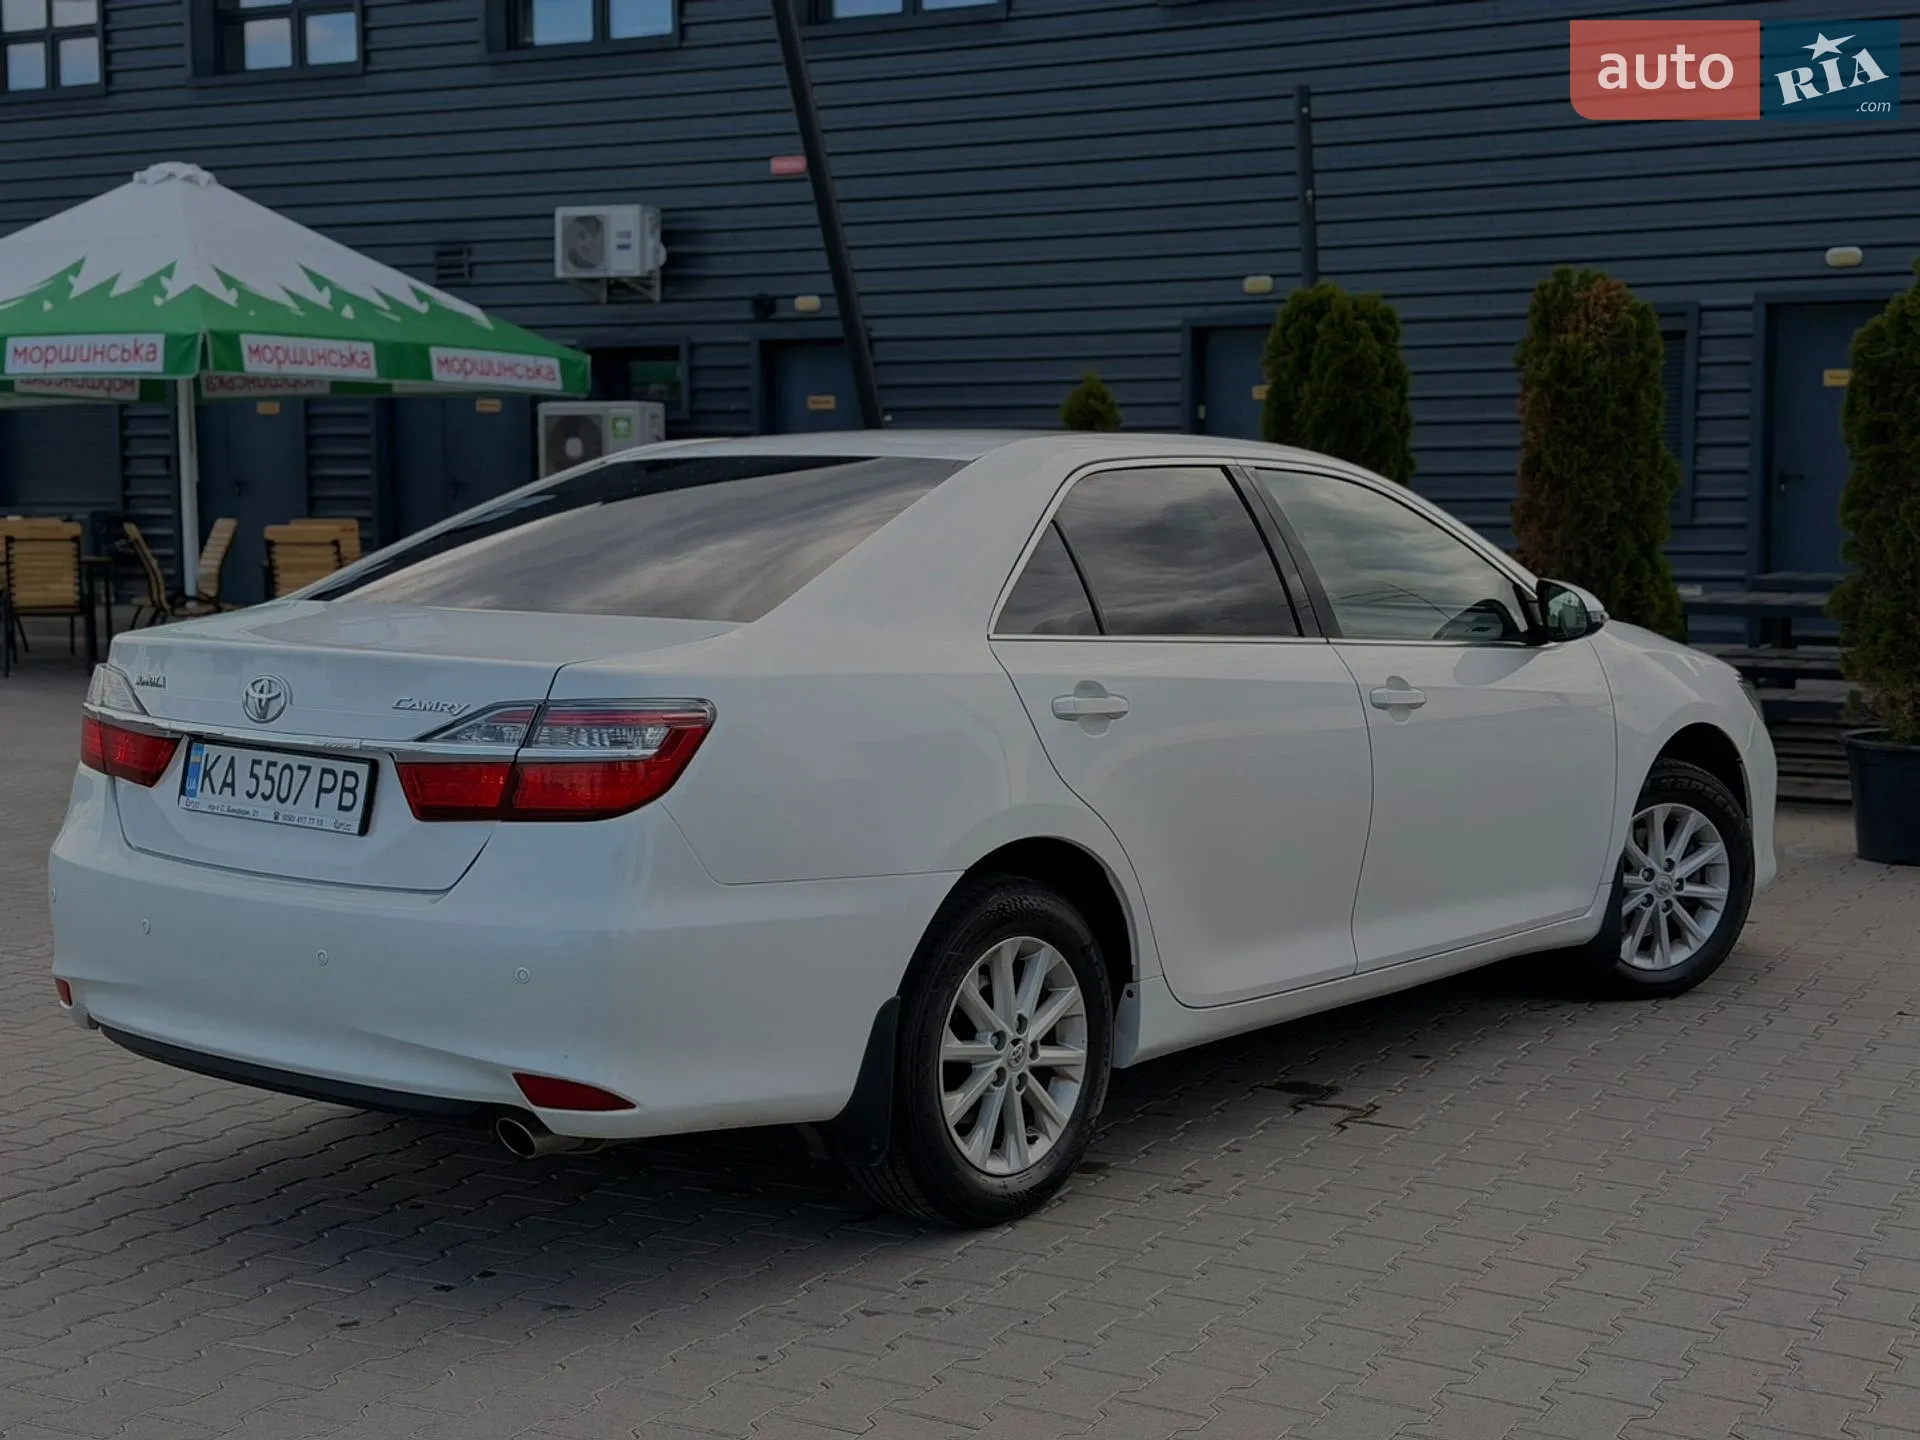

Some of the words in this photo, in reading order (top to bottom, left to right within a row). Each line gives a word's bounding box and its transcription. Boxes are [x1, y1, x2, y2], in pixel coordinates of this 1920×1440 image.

[13, 336, 158, 371] моршинська
[247, 344, 371, 372] моршинська
[436, 355, 557, 382] моршинська
[200, 753, 236, 797] KA
[245, 759, 312, 805] 5507
[315, 767, 360, 812] PB
